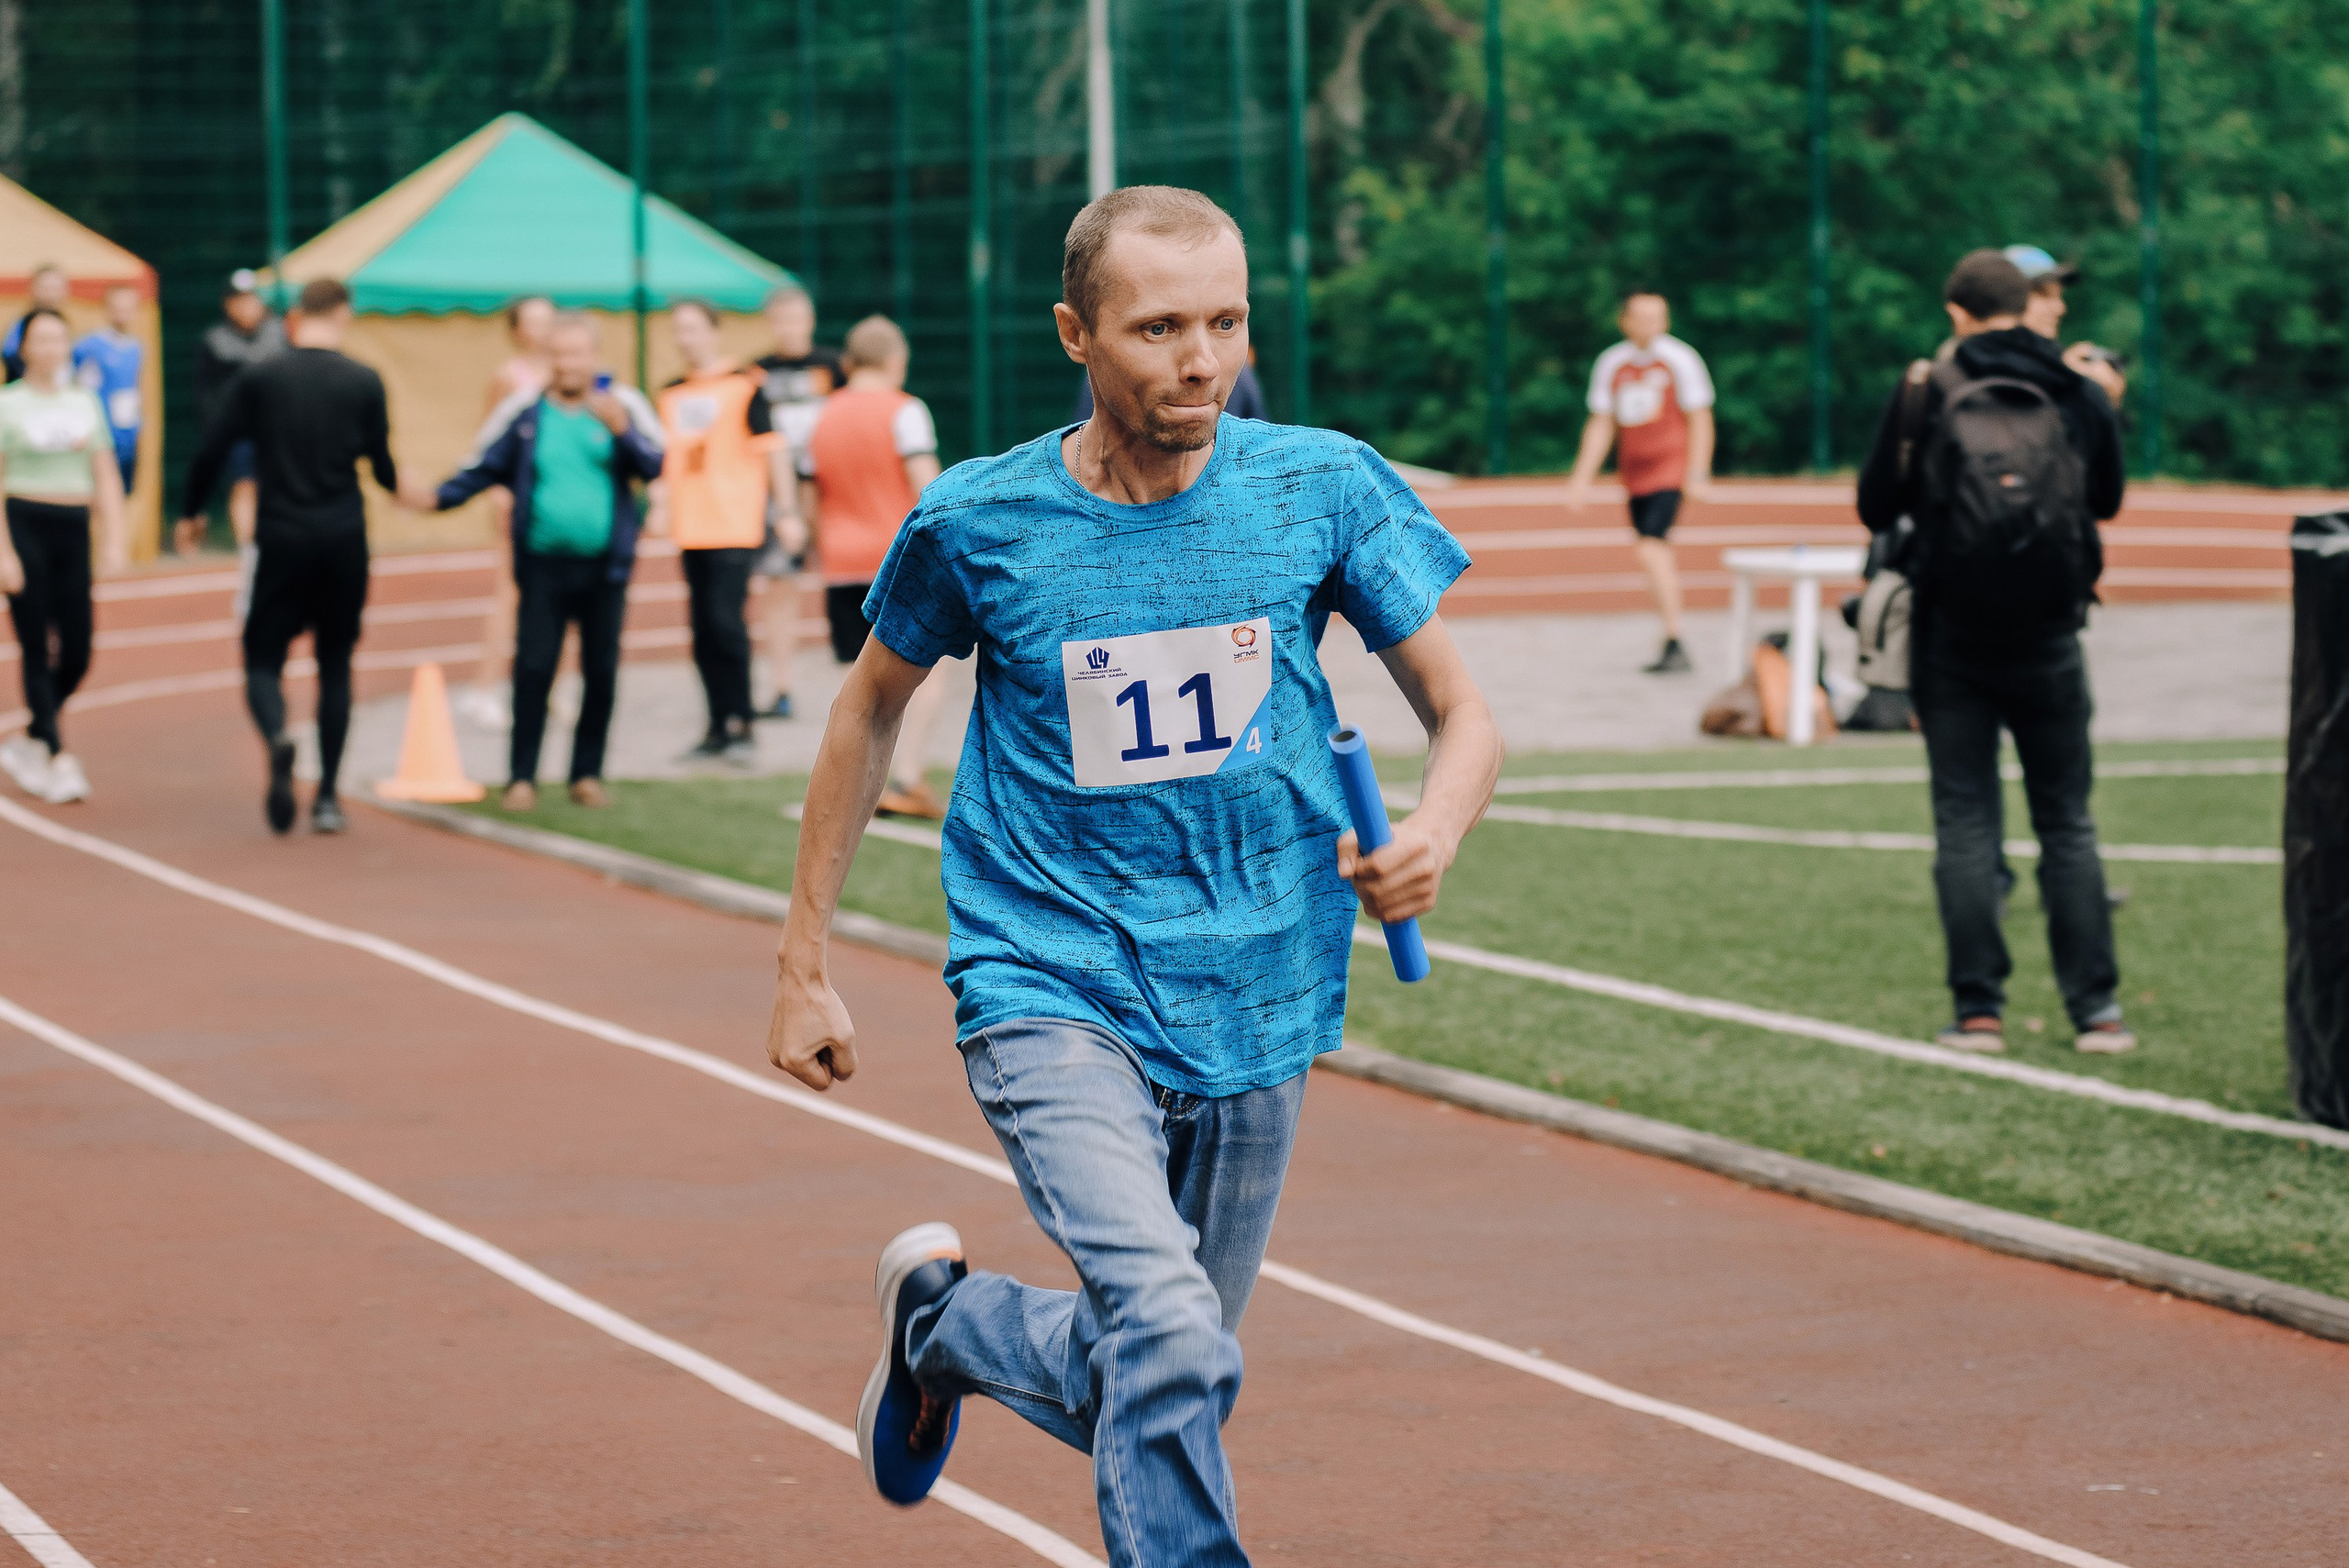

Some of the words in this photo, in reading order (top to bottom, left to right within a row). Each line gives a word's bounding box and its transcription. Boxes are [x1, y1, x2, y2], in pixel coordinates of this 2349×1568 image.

[1233, 649, 1259, 659] УГМК
[1234, 654, 1259, 664] UMMC
[1077, 667, 1122, 675] ЧЕЛЯБИНСКИЙ
[1116, 673, 1232, 762] 11
[1245, 726, 1263, 754] 4
